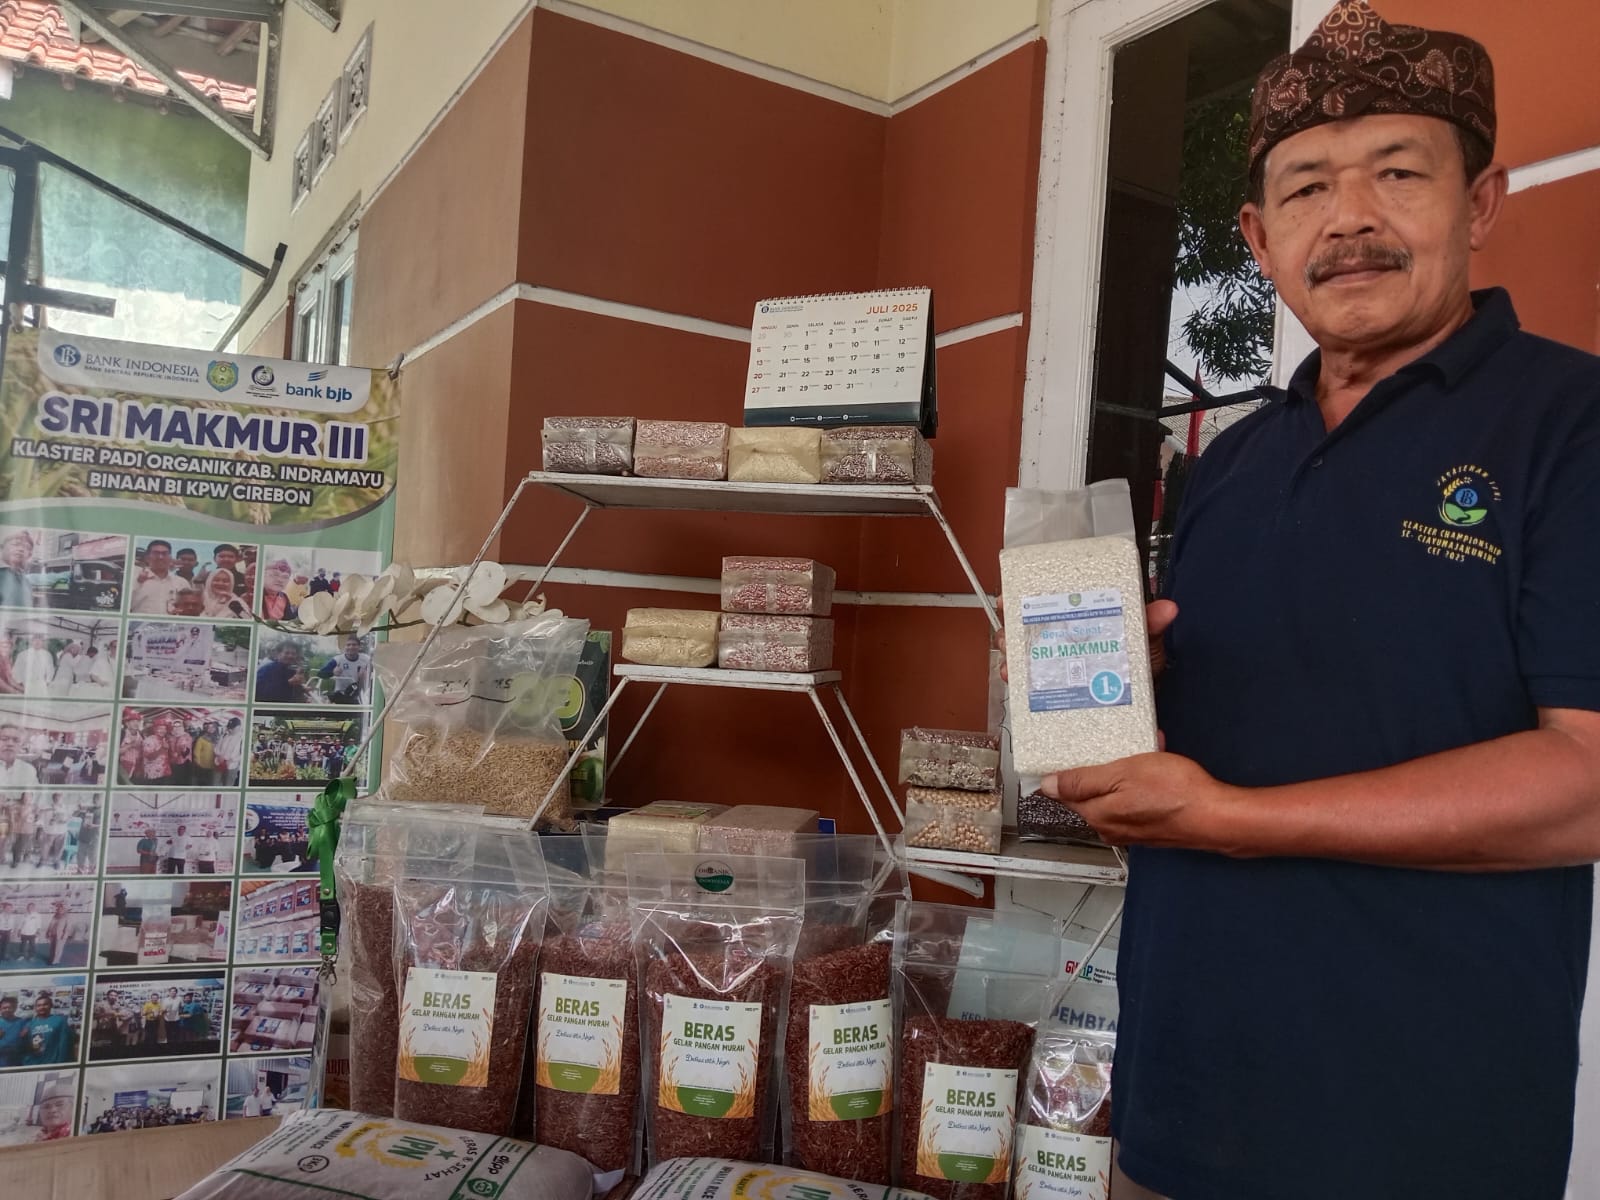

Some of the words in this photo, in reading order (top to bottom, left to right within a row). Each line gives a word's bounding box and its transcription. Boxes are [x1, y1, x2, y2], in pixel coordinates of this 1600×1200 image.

[866, 305, 889, 315] JULI
[891, 303, 918, 313] 2025
[828, 328, 834, 336] 2
[828, 342, 833, 350] 9
[851, 341, 860, 349] 10
[85, 353, 121, 368] BANK
[126, 358, 200, 377] INDONESIA
[753, 372, 763, 380] 20
[801, 370, 810, 378] 22
[895, 365, 905, 373] 26
[285, 383, 323, 399] bank
[326, 386, 353, 403] bjb
[751, 386, 761, 394] 27
[777, 385, 786, 393] 28
[40, 395, 114, 437] SRI
[124, 404, 318, 457] MAKMUR
[328, 425, 364, 460] III
[12, 440, 95, 463] KLASTER
[100, 451, 143, 468] PADI
[146, 454, 231, 474] ORGANIK
[235, 461, 276, 479] KAB.
[280, 465, 382, 487] INDRAMAYU
[89, 472, 160, 493] BINAAN
[164, 478, 182, 494] BI
[186, 481, 229, 499] KPW
[232, 486, 311, 505] CIREBON
[1402, 520, 1438, 536] KLASTER
[1440, 529, 1502, 556] CHAMPIONSHIP
[1031, 645, 1053, 660] SRI
[1057, 639, 1120, 657] MAKMUR
[1100, 675, 1111, 695] 1
[422, 991, 472, 1010] BERAS
[555, 996, 600, 1017] BERAS
[411, 1008, 431, 1017] GELAR
[432, 1010, 457, 1020] PANGAN
[457, 1012, 480, 1021] MURAH
[546, 1013, 563, 1023] GELAR
[563, 1016, 586, 1026] PANGAN
[587, 1019, 610, 1028] MURAH
[683, 1021, 735, 1042] BERAS
[833, 1023, 879, 1045] BERAS
[673, 1037, 693, 1048] GELAR
[694, 1041, 720, 1051] PANGAN
[721, 1044, 746, 1052] MURAH
[822, 1047, 844, 1055] GELAR
[845, 1044, 868, 1054] PANGAN
[869, 1041, 886, 1050] MURAH
[946, 1088, 997, 1108] BERAS
[935, 1105, 956, 1116] GELAR
[957, 1108, 982, 1118] PANGAN
[983, 1110, 1005, 1119] MURAH
[458, 1135, 479, 1156] BERAS
[1036, 1149, 1087, 1172] BERAS
[423, 1161, 467, 1181] SEHAT
[1027, 1163, 1046, 1176] GELAR
[1047, 1169, 1072, 1181] PANGAN
[1073, 1174, 1097, 1184] MURAH
